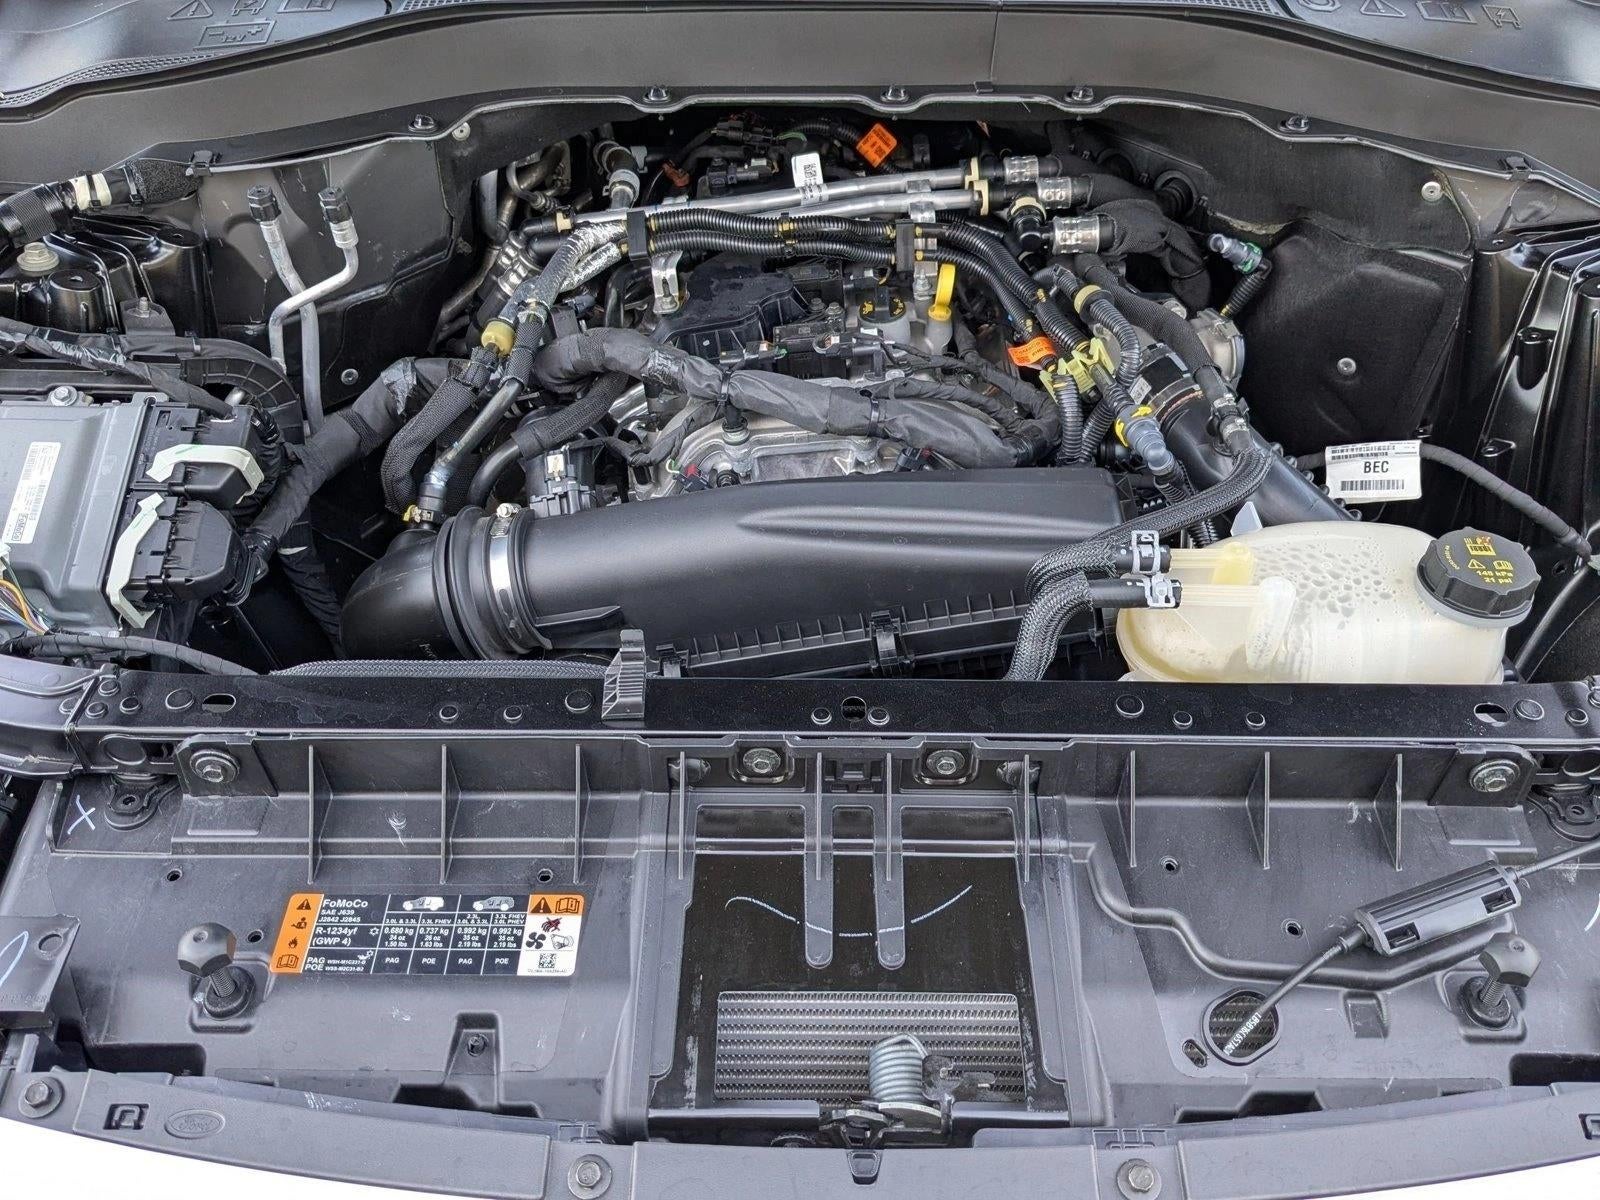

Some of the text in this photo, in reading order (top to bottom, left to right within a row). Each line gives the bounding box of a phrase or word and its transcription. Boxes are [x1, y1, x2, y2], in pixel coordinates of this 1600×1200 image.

[1363, 461, 1389, 473] BEC
[323, 899, 368, 908] FoMoCo
[315, 927, 358, 936] R-1234yf
[404, 927, 414, 936] kg
[439, 927, 449, 936] kg
[477, 927, 487, 936] kg
[492, 927, 522, 936] 0.992 kg
[312, 937, 351, 947] (GWP 4)
[304, 963, 324, 971] POE
